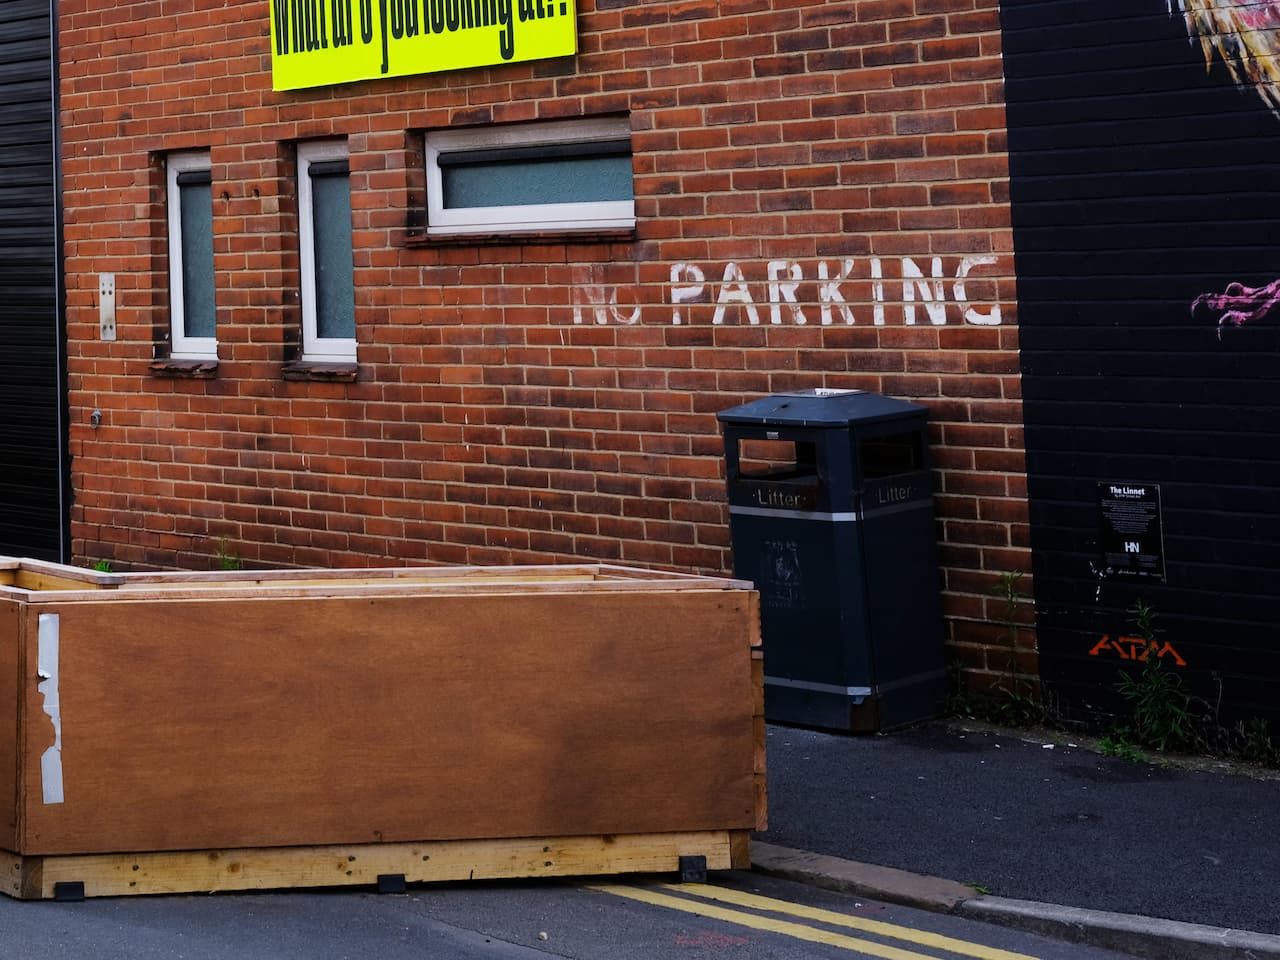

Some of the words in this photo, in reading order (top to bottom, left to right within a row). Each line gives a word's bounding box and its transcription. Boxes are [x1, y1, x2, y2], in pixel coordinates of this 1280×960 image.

[572, 265, 641, 325] NO
[669, 255, 1002, 326] PARKING
[757, 487, 801, 507] Litter
[878, 485, 912, 503] Litter
[1109, 486, 1122, 494] The
[1123, 486, 1145, 496] Linnet
